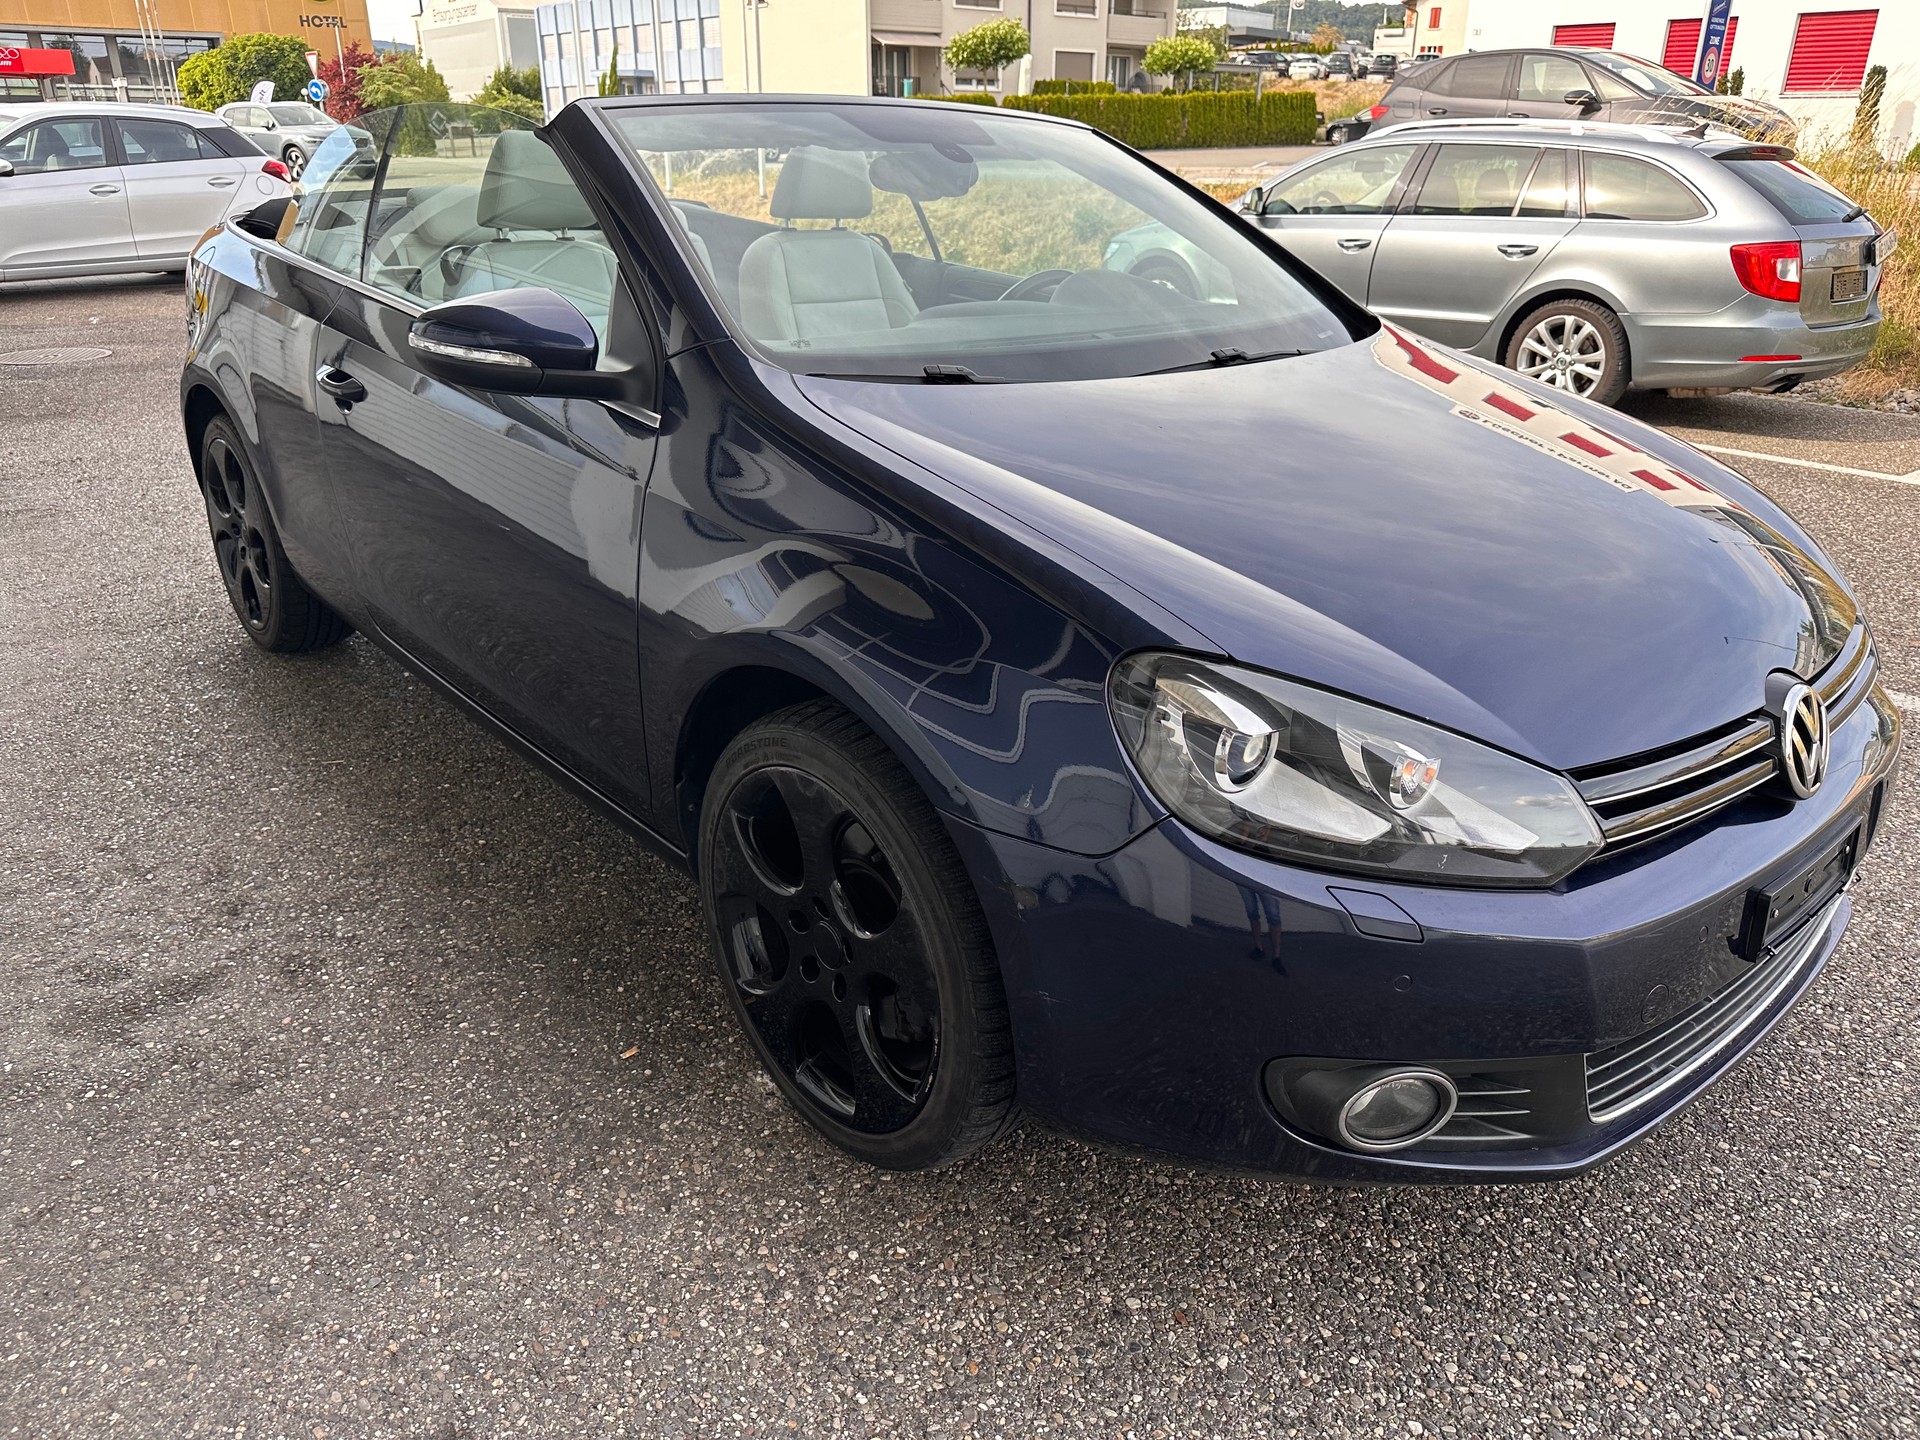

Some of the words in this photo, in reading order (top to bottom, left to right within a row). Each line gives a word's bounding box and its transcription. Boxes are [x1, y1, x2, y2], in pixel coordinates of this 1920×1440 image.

[299, 15, 347, 29] HOTEL
[1709, 36, 1720, 45] ZONE
[1705, 58, 1714, 72] 30
[726, 736, 788, 769] ROADSTONE
